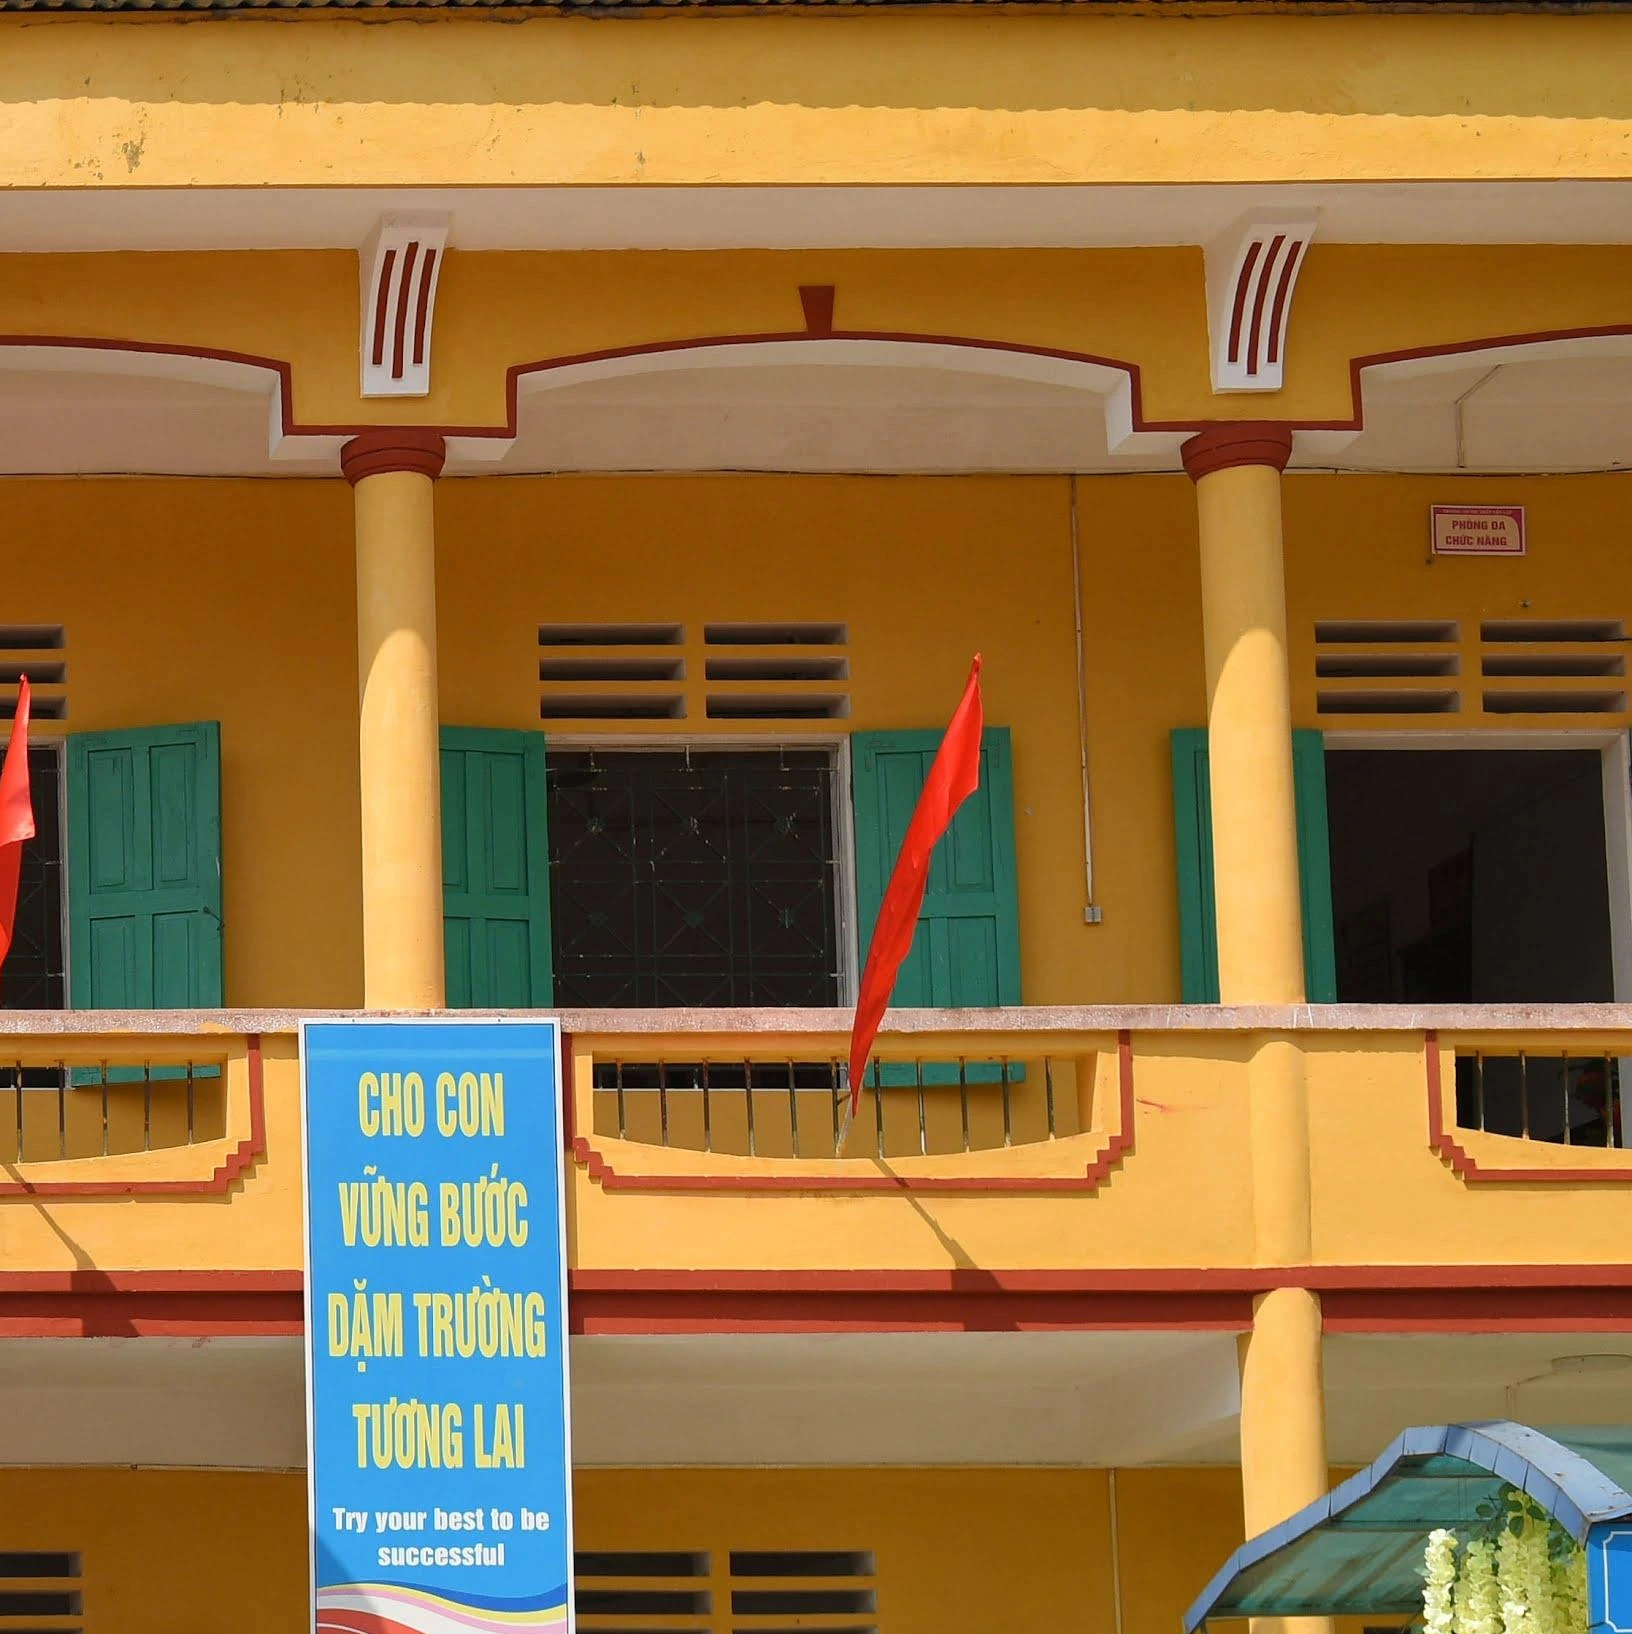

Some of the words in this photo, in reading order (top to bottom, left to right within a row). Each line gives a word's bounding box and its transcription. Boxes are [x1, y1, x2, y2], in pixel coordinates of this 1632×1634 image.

[358, 1071, 425, 1137] CHO
[435, 1071, 504, 1136] CON
[338, 1164, 429, 1248] VỮNG
[440, 1162, 529, 1248] BƯỚC
[328, 1278, 402, 1372] DẶM
[413, 1277, 546, 1359] TRƯỜNG
[353, 1396, 463, 1470] TƯƠNG
[473, 1403, 525, 1469] LAI
[332, 1507, 368, 1534] Try
[374, 1511, 426, 1533] your
[433, 1507, 484, 1531] best
[489, 1508, 515, 1531] to
[520, 1507, 549, 1531] be
[377, 1540, 505, 1566] successful
